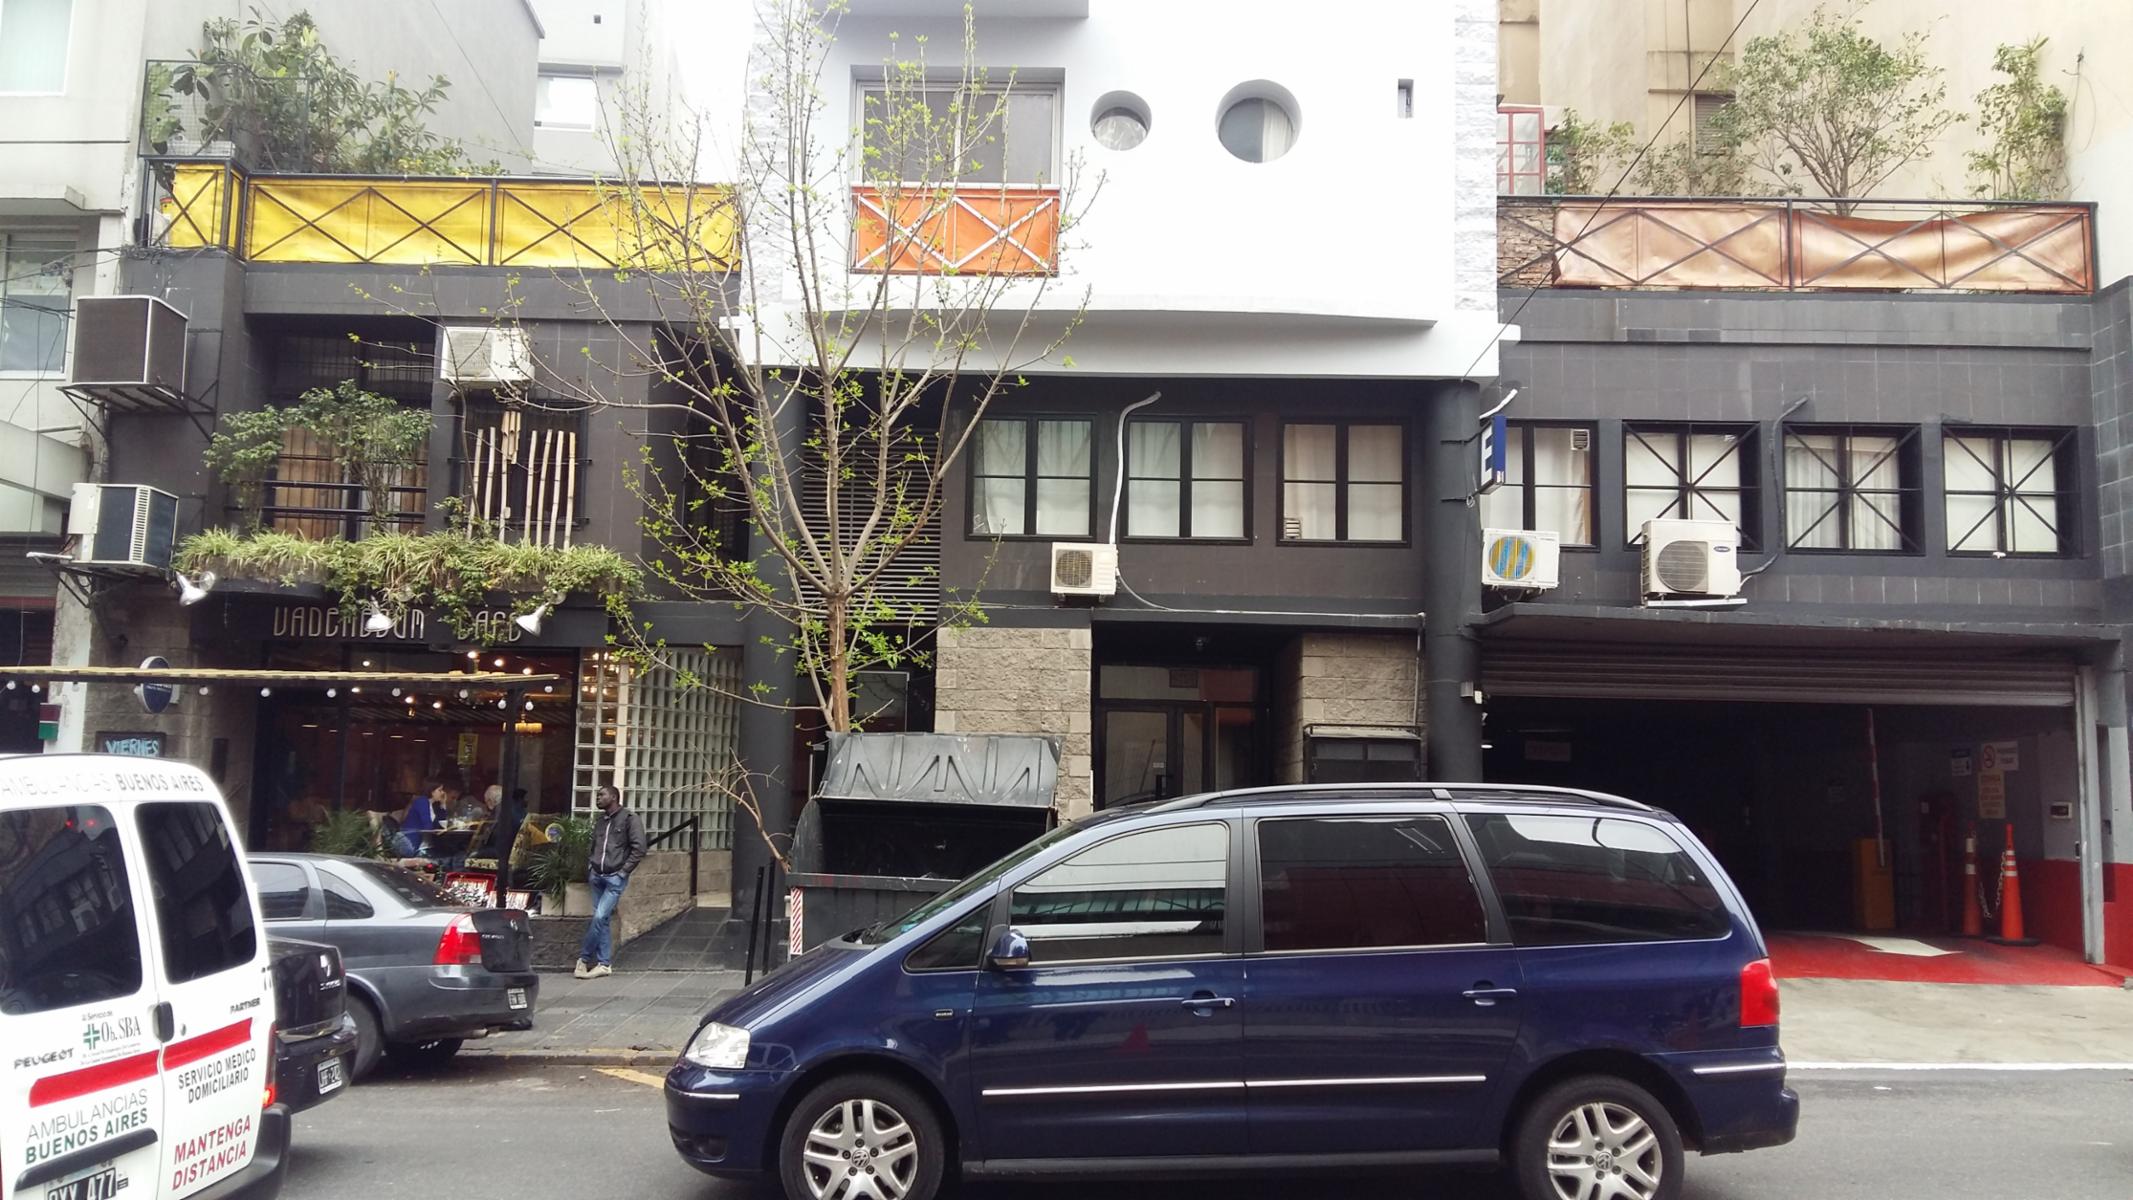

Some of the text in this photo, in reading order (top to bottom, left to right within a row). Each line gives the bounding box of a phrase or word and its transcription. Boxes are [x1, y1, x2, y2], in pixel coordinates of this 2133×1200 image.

[105, 738, 159, 757] VIERNES
[2, 773, 205, 796] AMBULANCAS BUENOS AIRES
[230, 997, 260, 1014] PARTNER
[14, 1048, 74, 1069] PEUGEOT
[178, 1047, 256, 1090] SERVICIO MEDICO
[188, 1067, 249, 1104] DOMICILIARIO
[26, 1088, 148, 1143] AMBULANCIAS
[26, 1107, 148, 1165] BUENOS AIRES
[174, 1115, 251, 1164] MANTENGA
[87, 1169, 116, 1200] 477
[172, 1141, 247, 1191] DISTANCIA
